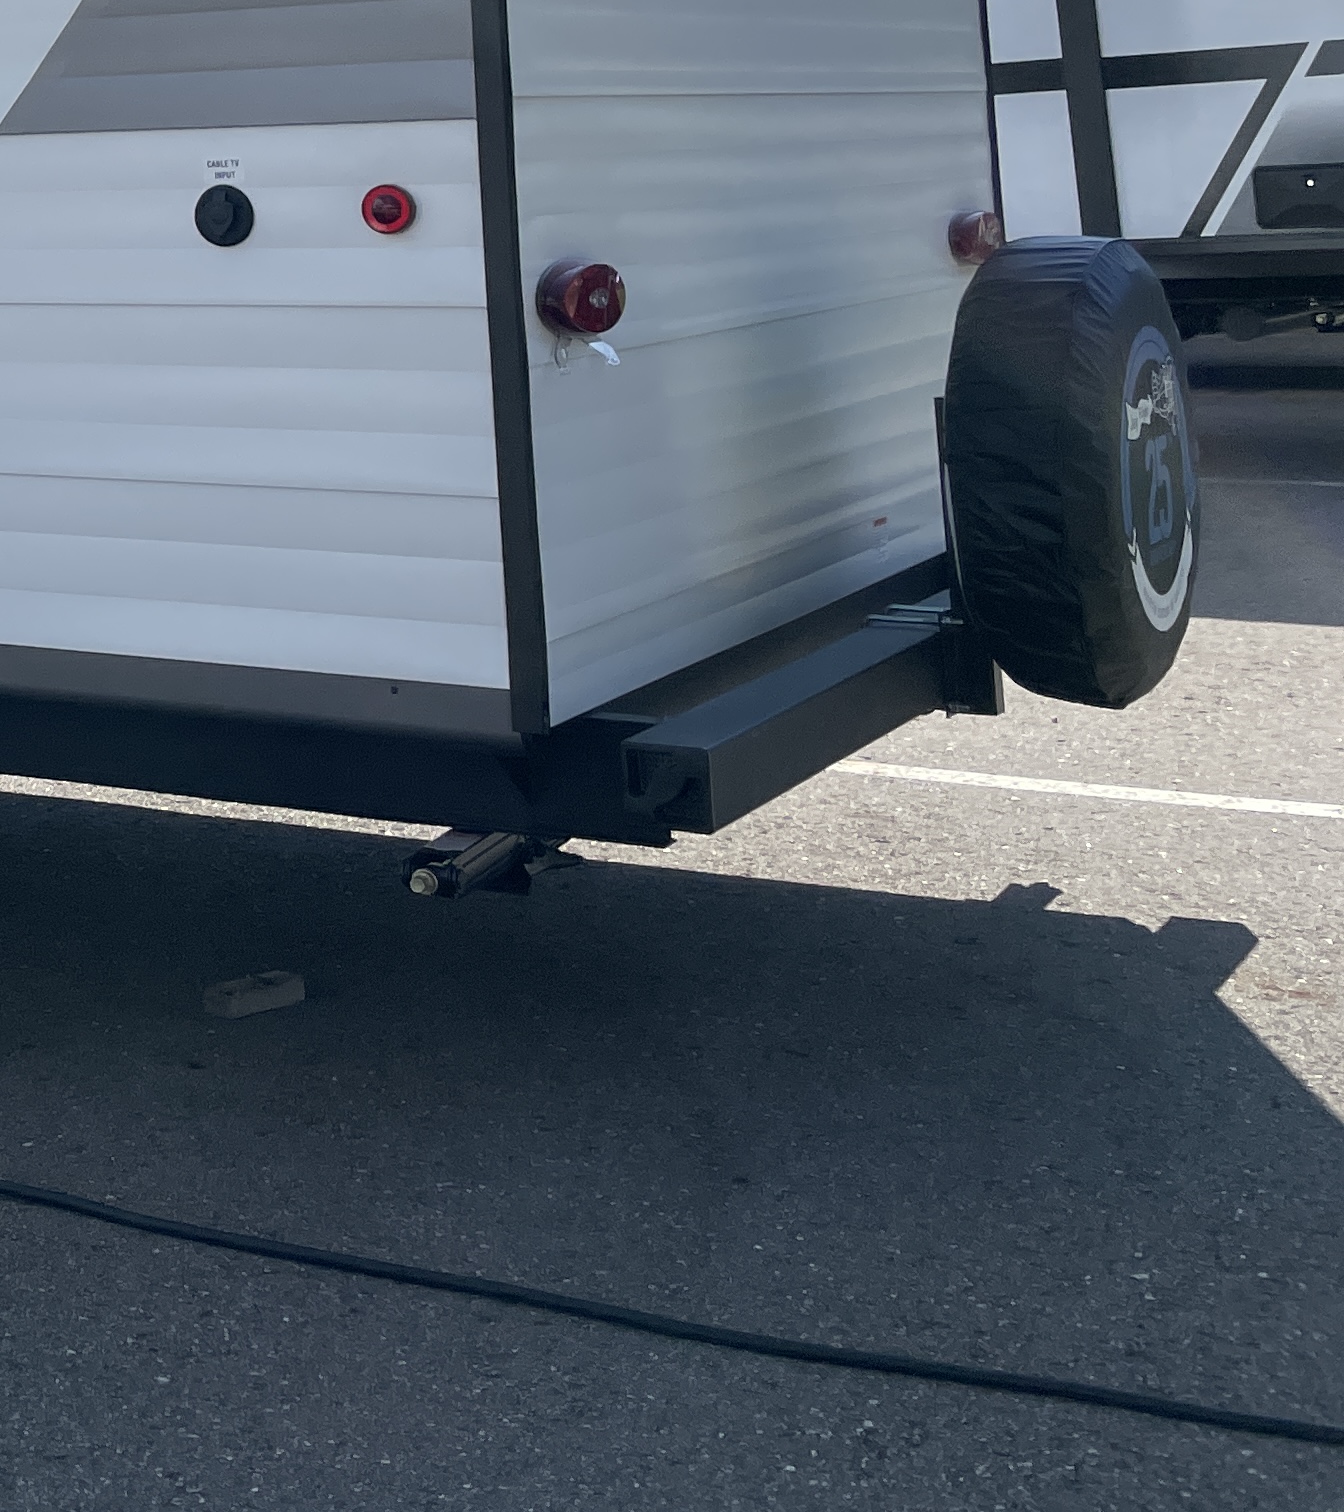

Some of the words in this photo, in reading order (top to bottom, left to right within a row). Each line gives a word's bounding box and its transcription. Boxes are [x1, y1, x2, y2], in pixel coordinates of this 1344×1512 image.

[206, 159, 229, 168] CABLE
[230, 158, 240, 167] TV
[214, 170, 236, 179] INPUT
